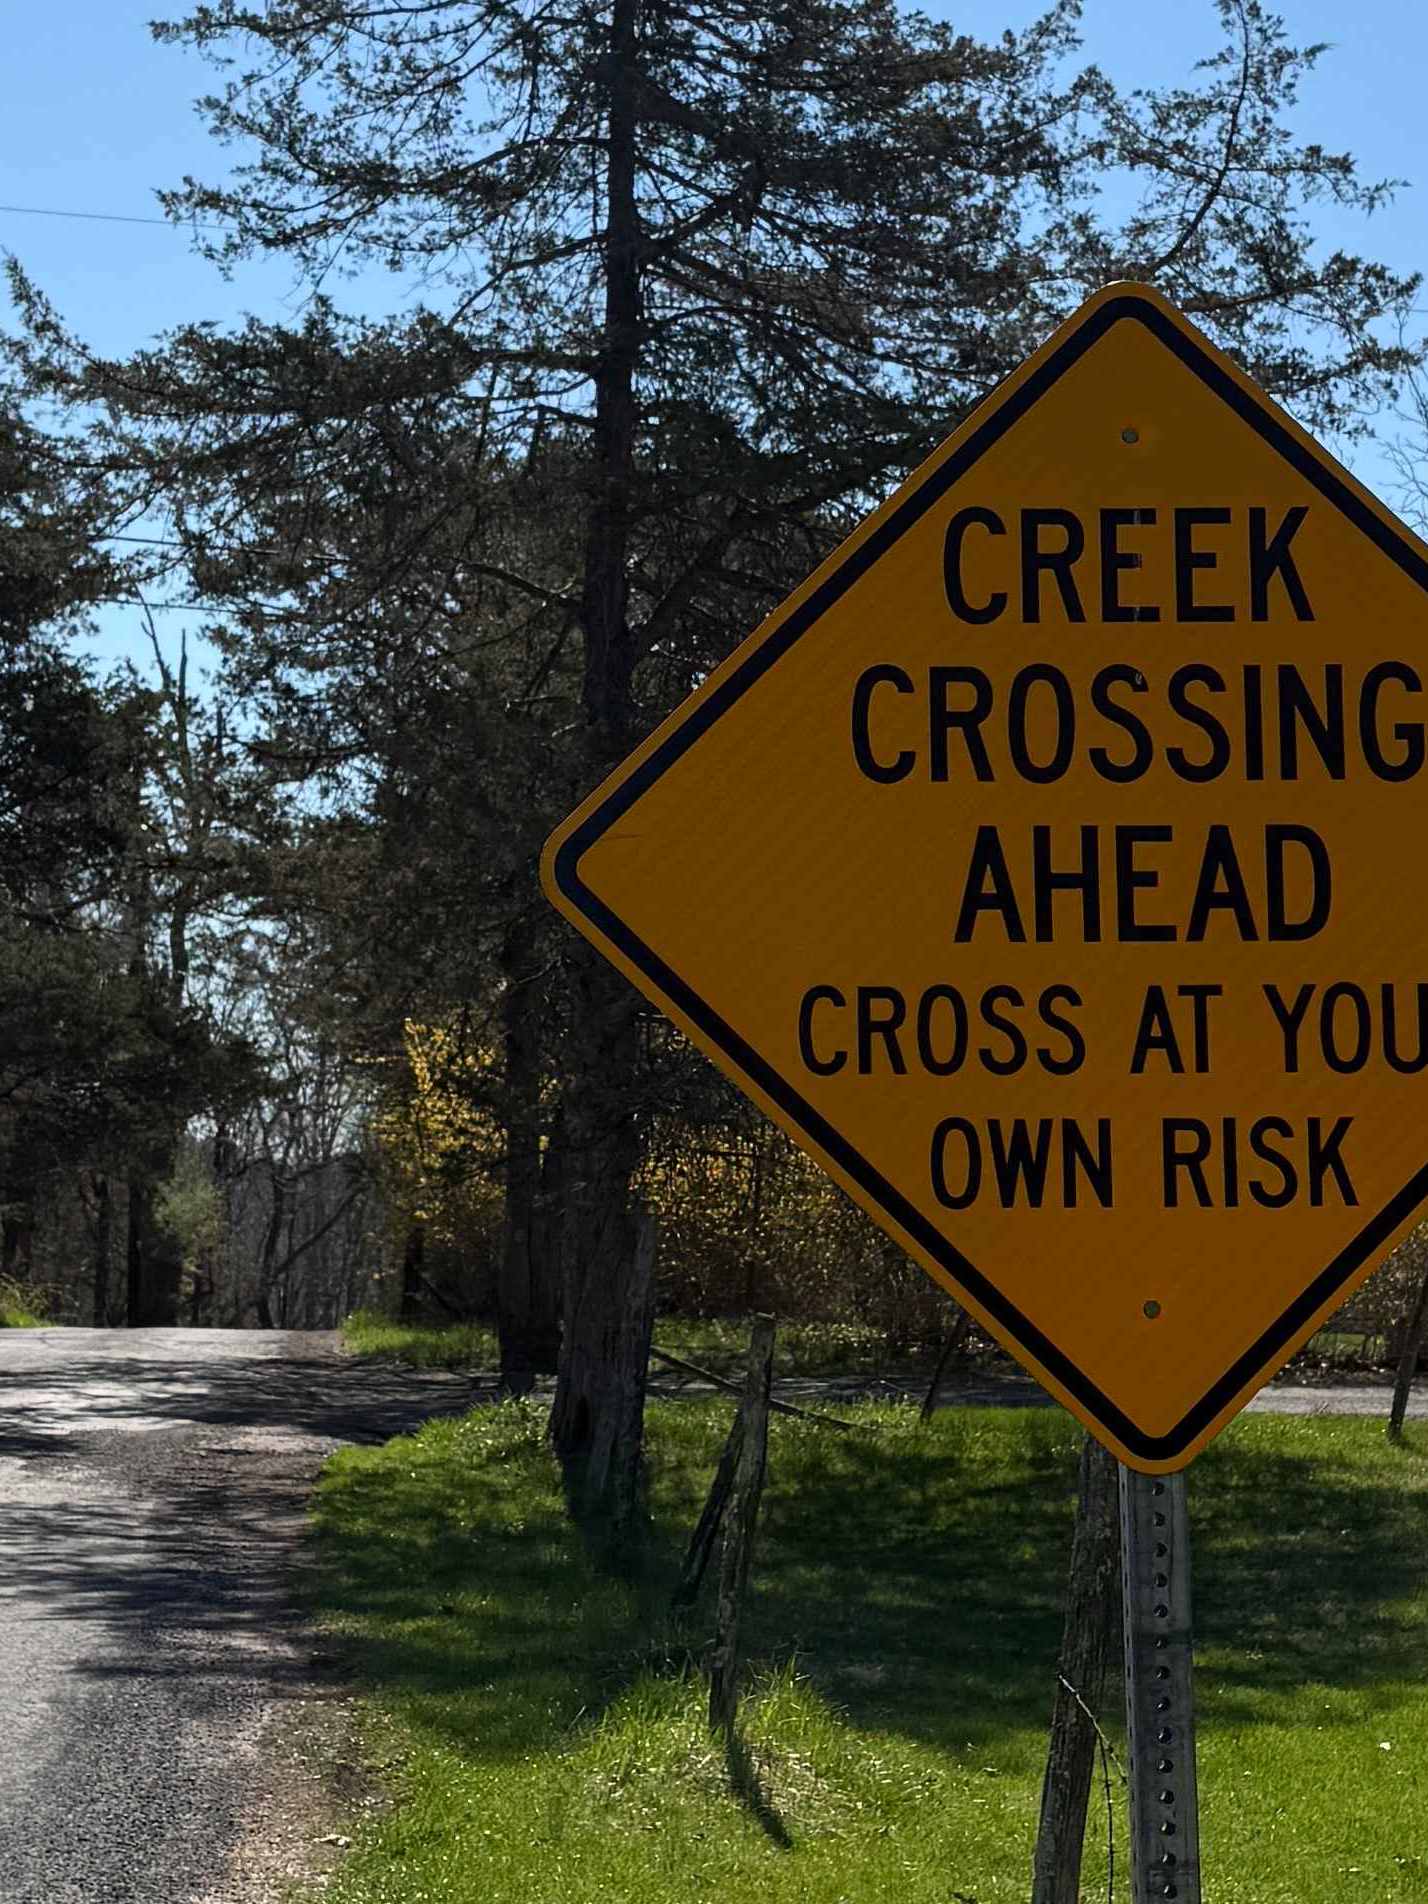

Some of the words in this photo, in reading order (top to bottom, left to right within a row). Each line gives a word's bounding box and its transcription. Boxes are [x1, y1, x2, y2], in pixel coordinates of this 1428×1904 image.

[942, 504, 1315, 625] CREEK
[851, 661, 1426, 785] CROSSING
[954, 823, 1332, 943] AHEAD
[798, 983, 1086, 1077] CROSS
[1130, 984, 1223, 1074] AT
[930, 1116, 1113, 1210] OWN
[1162, 1116, 1358, 1209] RISK
